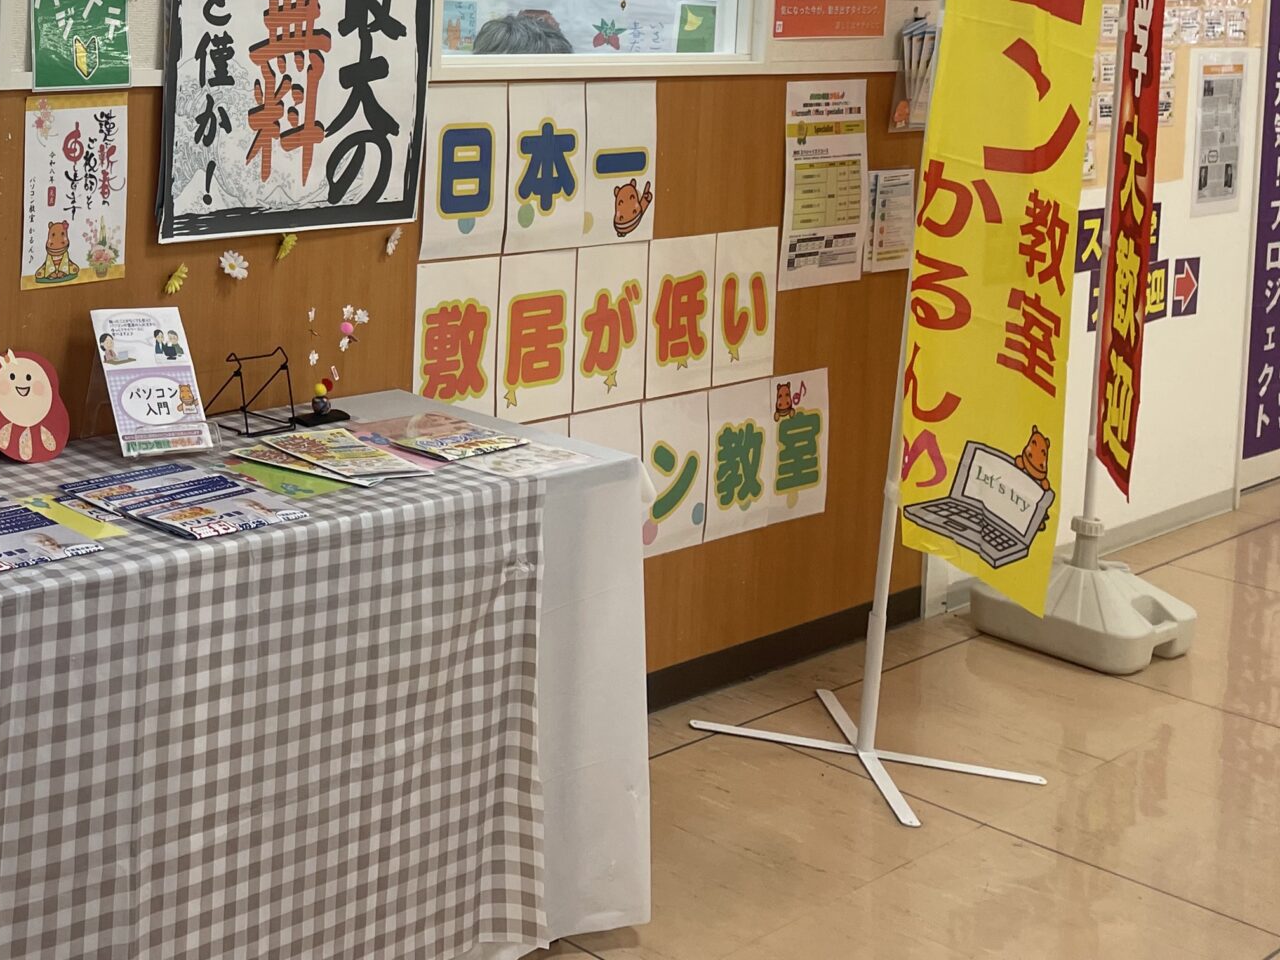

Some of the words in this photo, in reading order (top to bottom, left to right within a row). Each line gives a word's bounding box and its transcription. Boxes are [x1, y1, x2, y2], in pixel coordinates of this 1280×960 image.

[436, 116, 650, 220] 日本一
[420, 269, 770, 404] 敷居が低い
[995, 188, 1070, 399] 教室
[128, 386, 179, 401] パソコン
[145, 401, 171, 416] 入門
